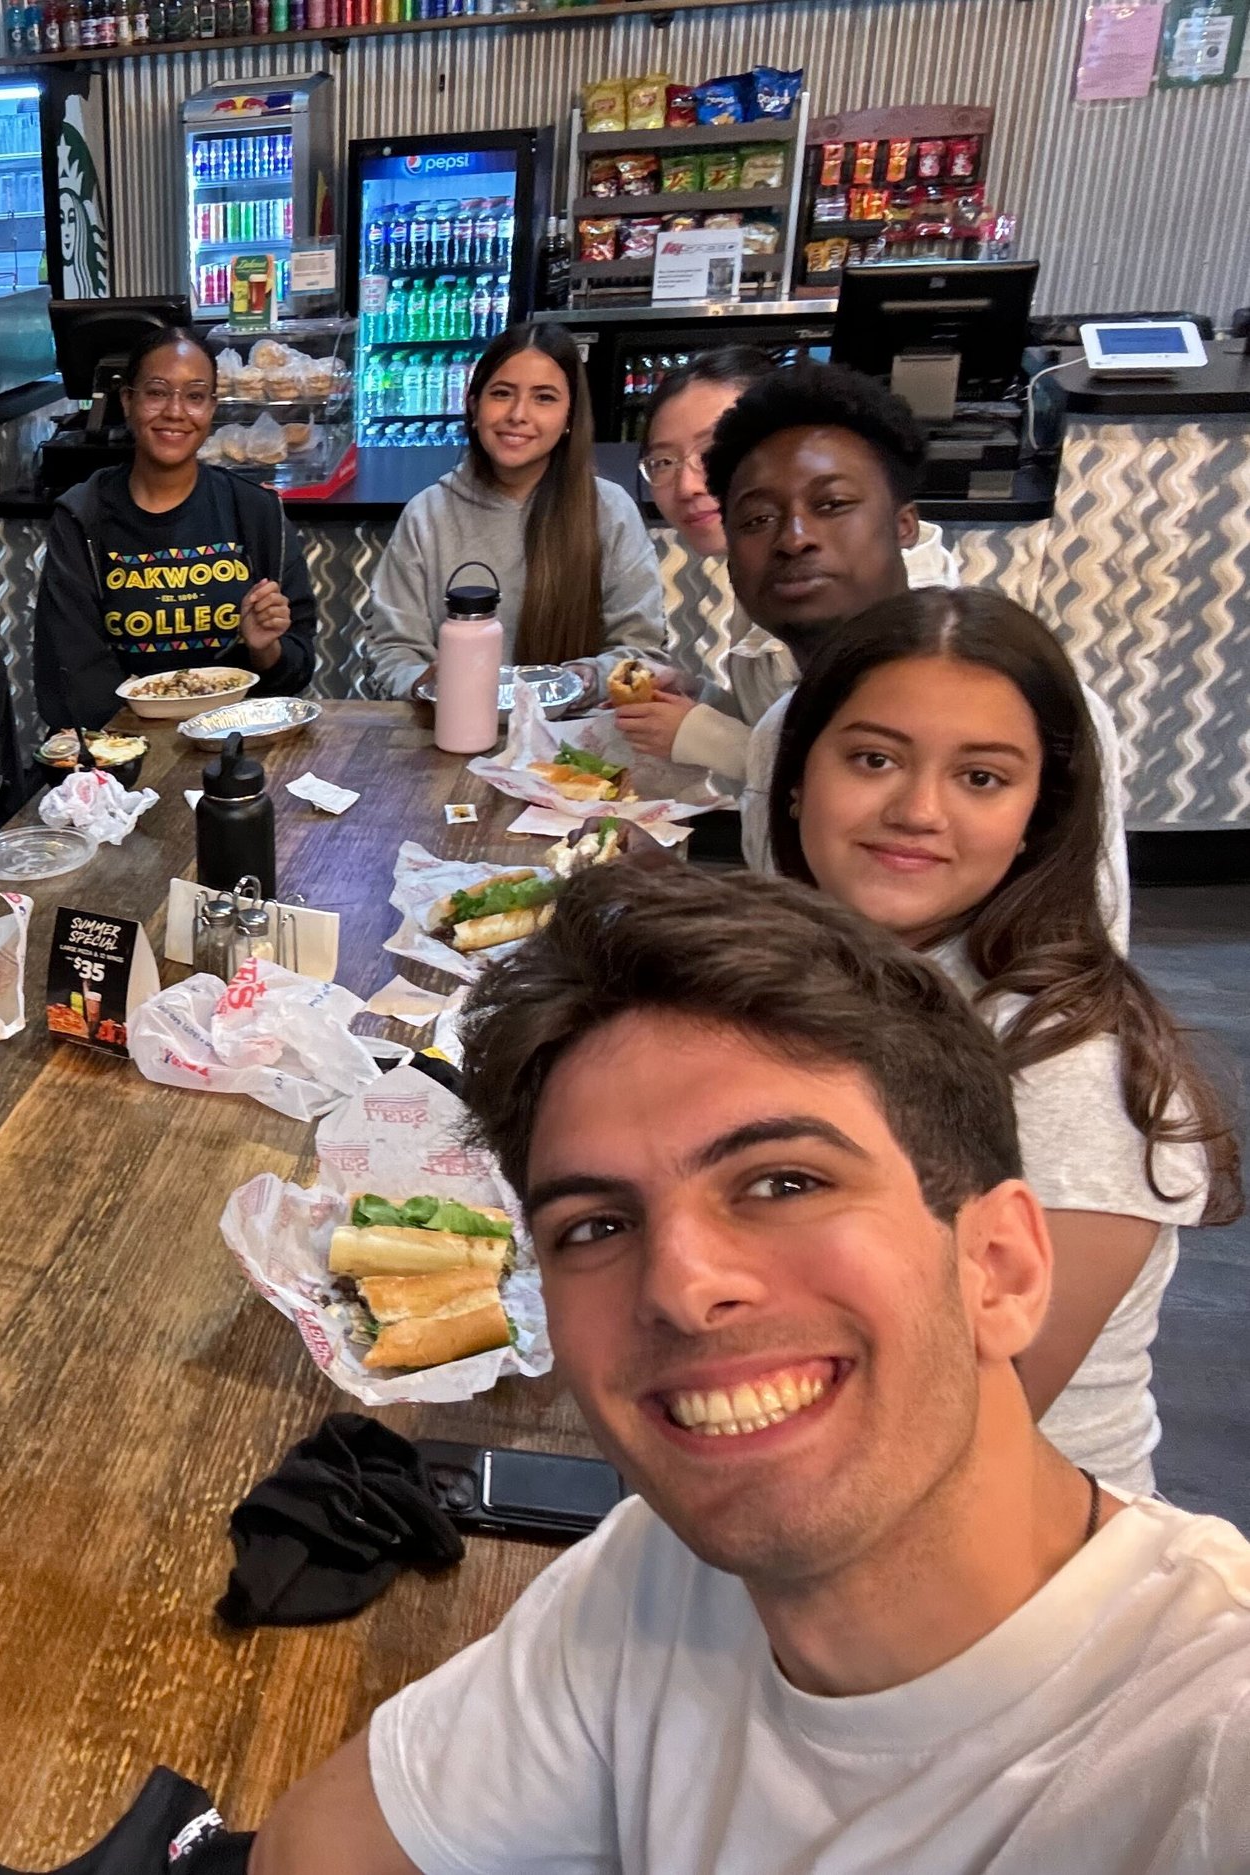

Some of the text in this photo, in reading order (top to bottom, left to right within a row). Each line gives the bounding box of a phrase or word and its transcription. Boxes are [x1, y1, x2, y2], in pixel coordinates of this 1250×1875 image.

[425, 153, 470, 173] pepsi
[106, 559, 249, 590] OAKWOOD
[104, 603, 241, 637] COLLEG
[70, 917, 122, 939] SUMMER
[68, 930, 118, 951] SPECIAL
[73, 956, 106, 982] $35
